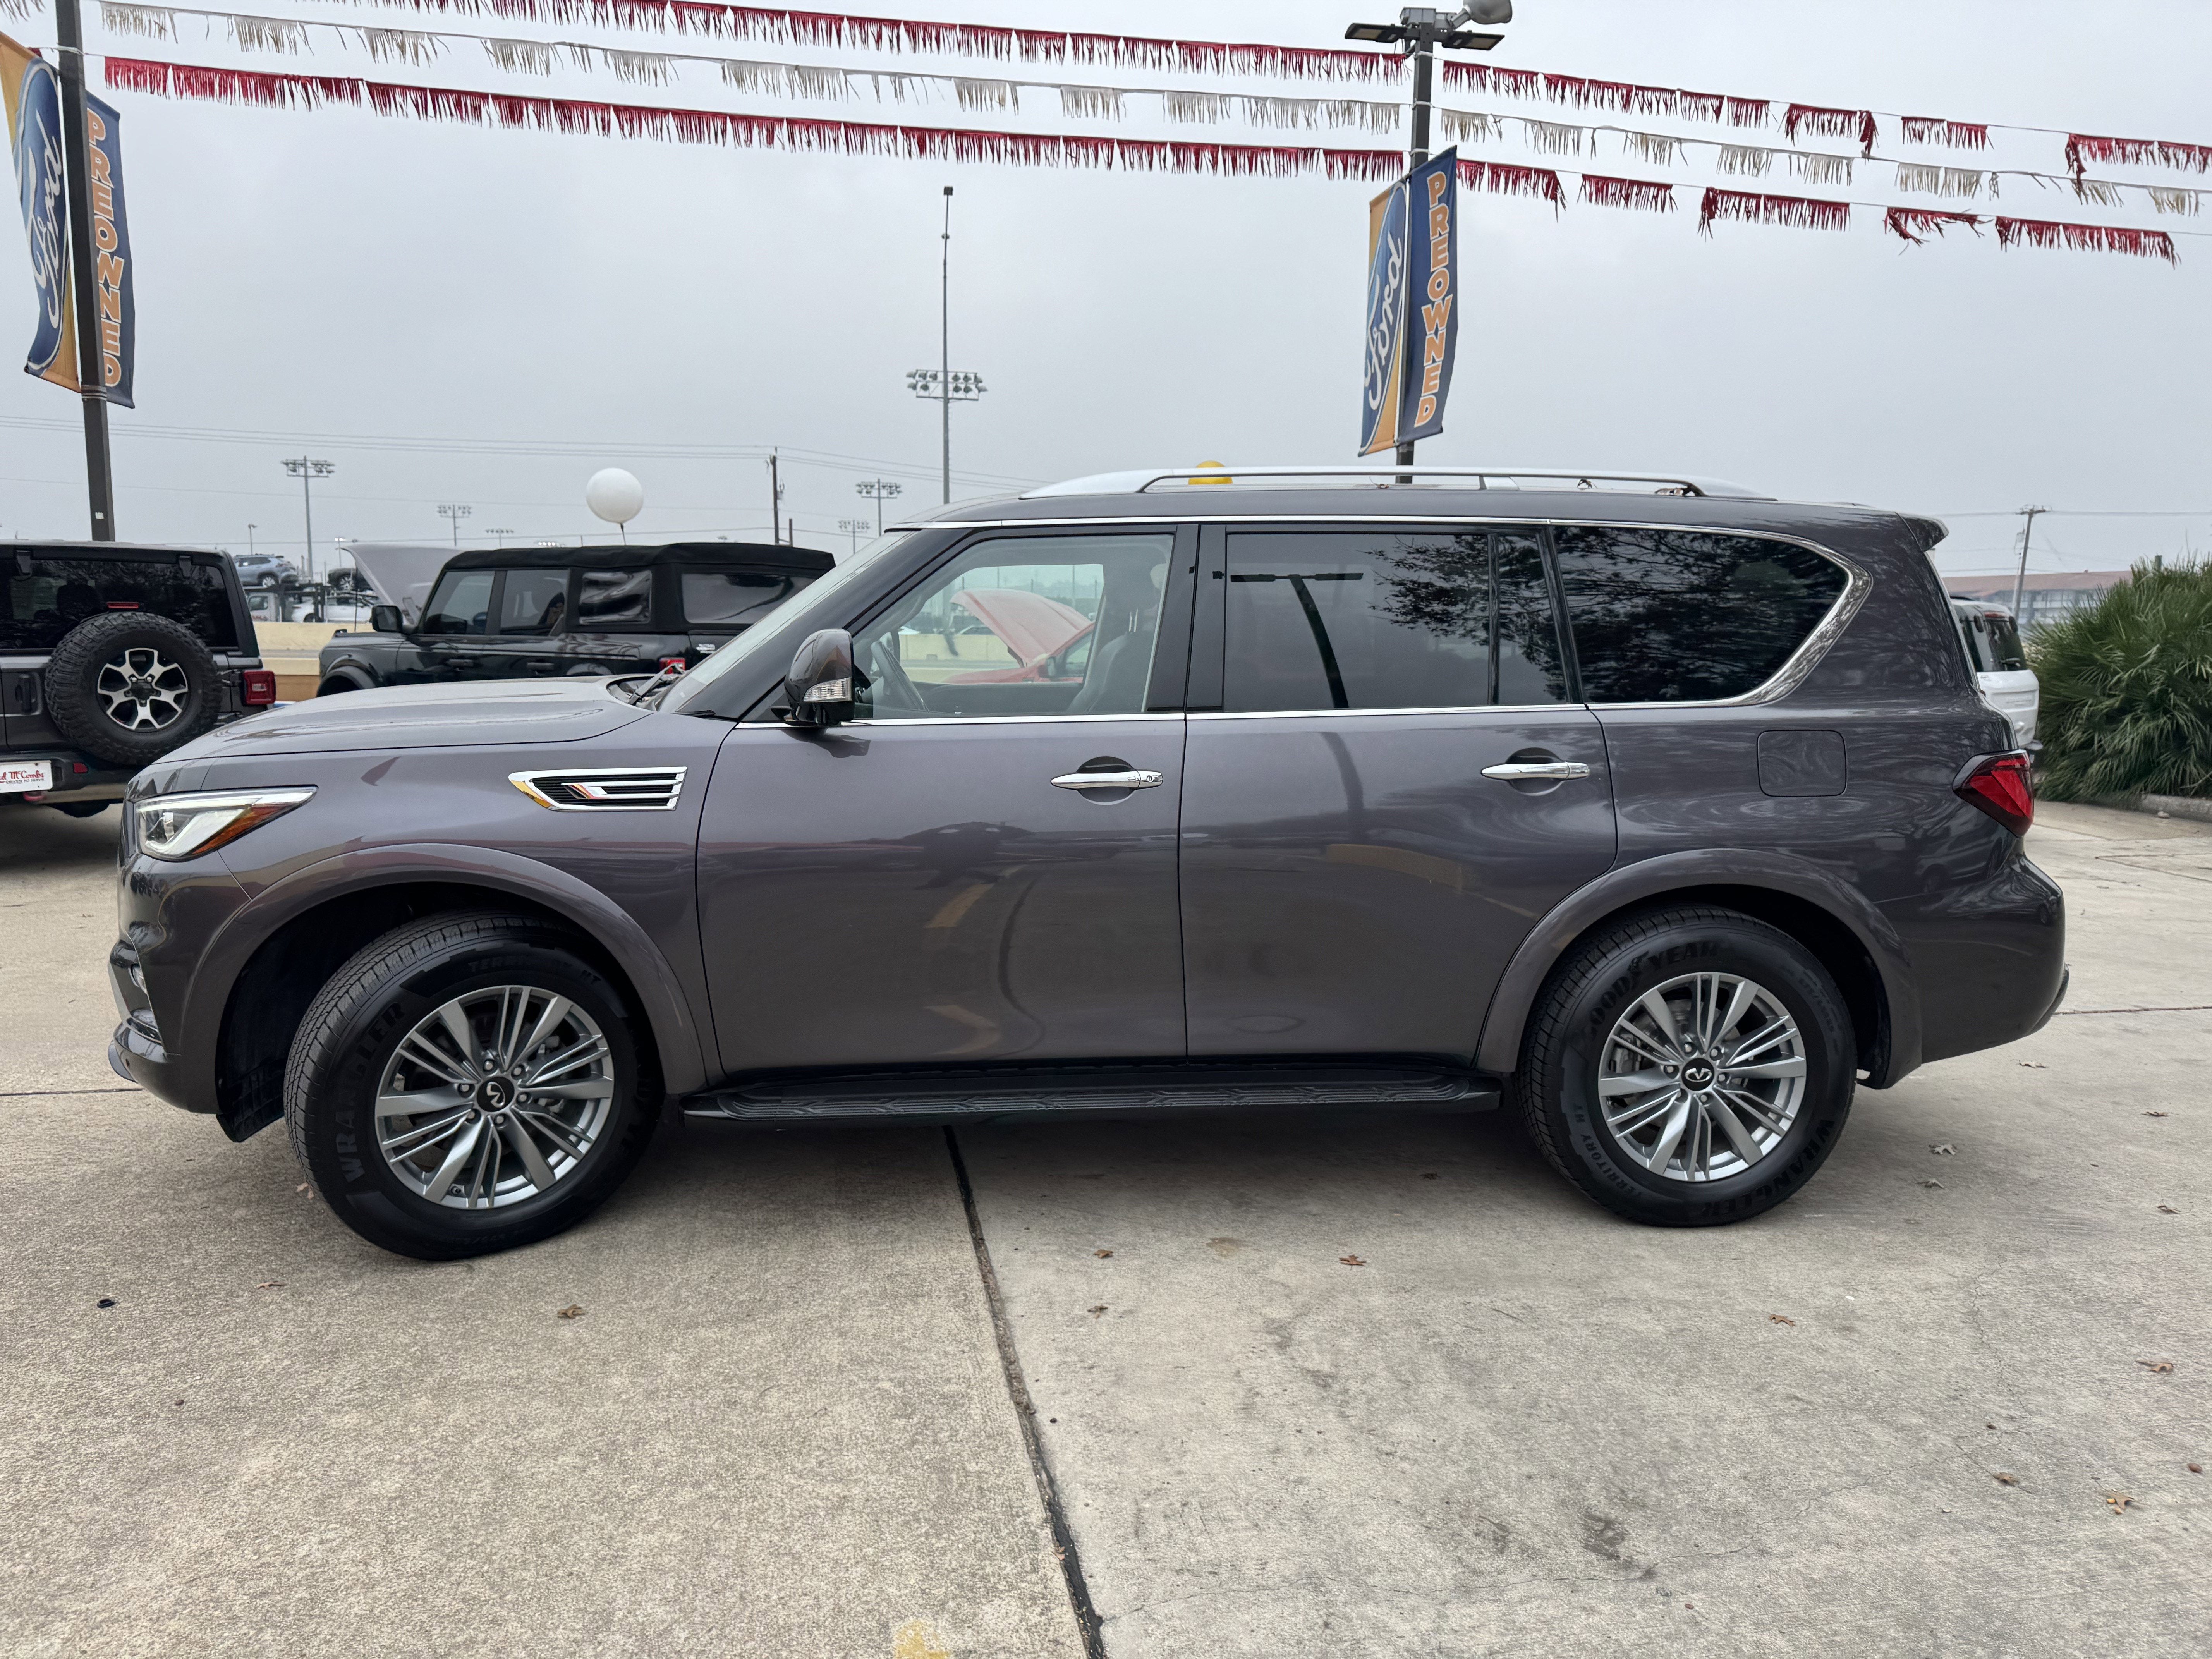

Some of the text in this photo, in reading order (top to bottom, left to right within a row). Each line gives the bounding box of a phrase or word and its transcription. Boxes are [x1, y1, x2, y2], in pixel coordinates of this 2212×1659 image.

[27, 106, 63, 330] Ford
[1414, 170, 1453, 429] PREOWNED
[1363, 230, 1403, 412] Ford
[8, 770, 45, 779] McCombs
[1701, 1118, 1836, 1217] WRANGLER
